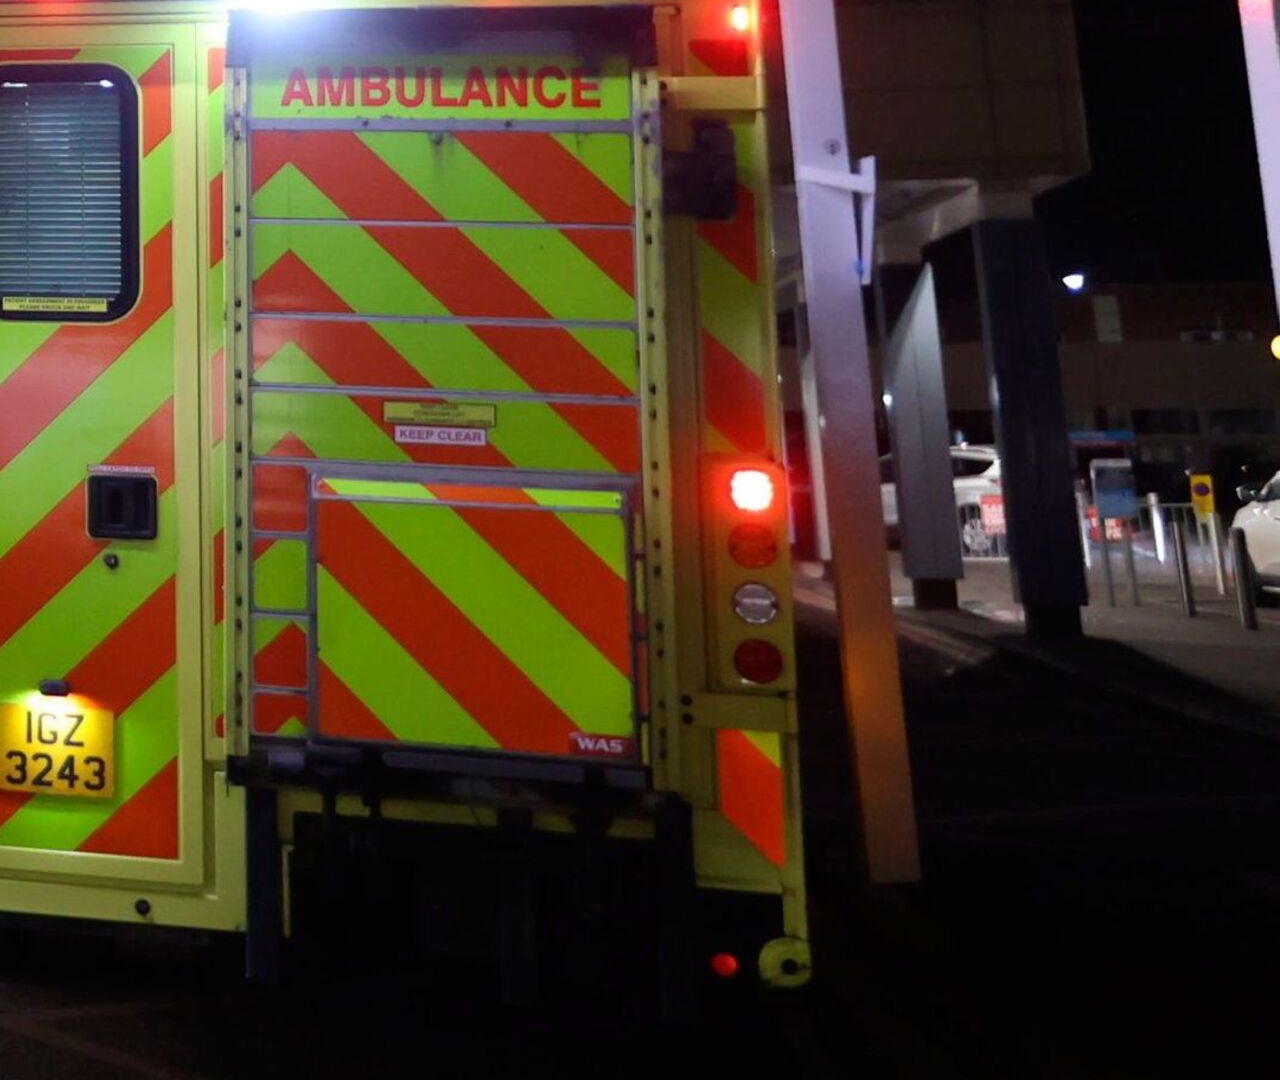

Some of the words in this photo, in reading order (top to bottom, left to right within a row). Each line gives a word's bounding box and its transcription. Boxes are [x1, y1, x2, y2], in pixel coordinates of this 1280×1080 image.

[281, 66, 602, 109] AMBULANCE
[399, 429, 433, 440] KEEP
[437, 430, 482, 442] CLEAR
[26, 710, 84, 747] IGZ
[576, 737, 623, 753] WAS
[5, 750, 106, 791] 3243
